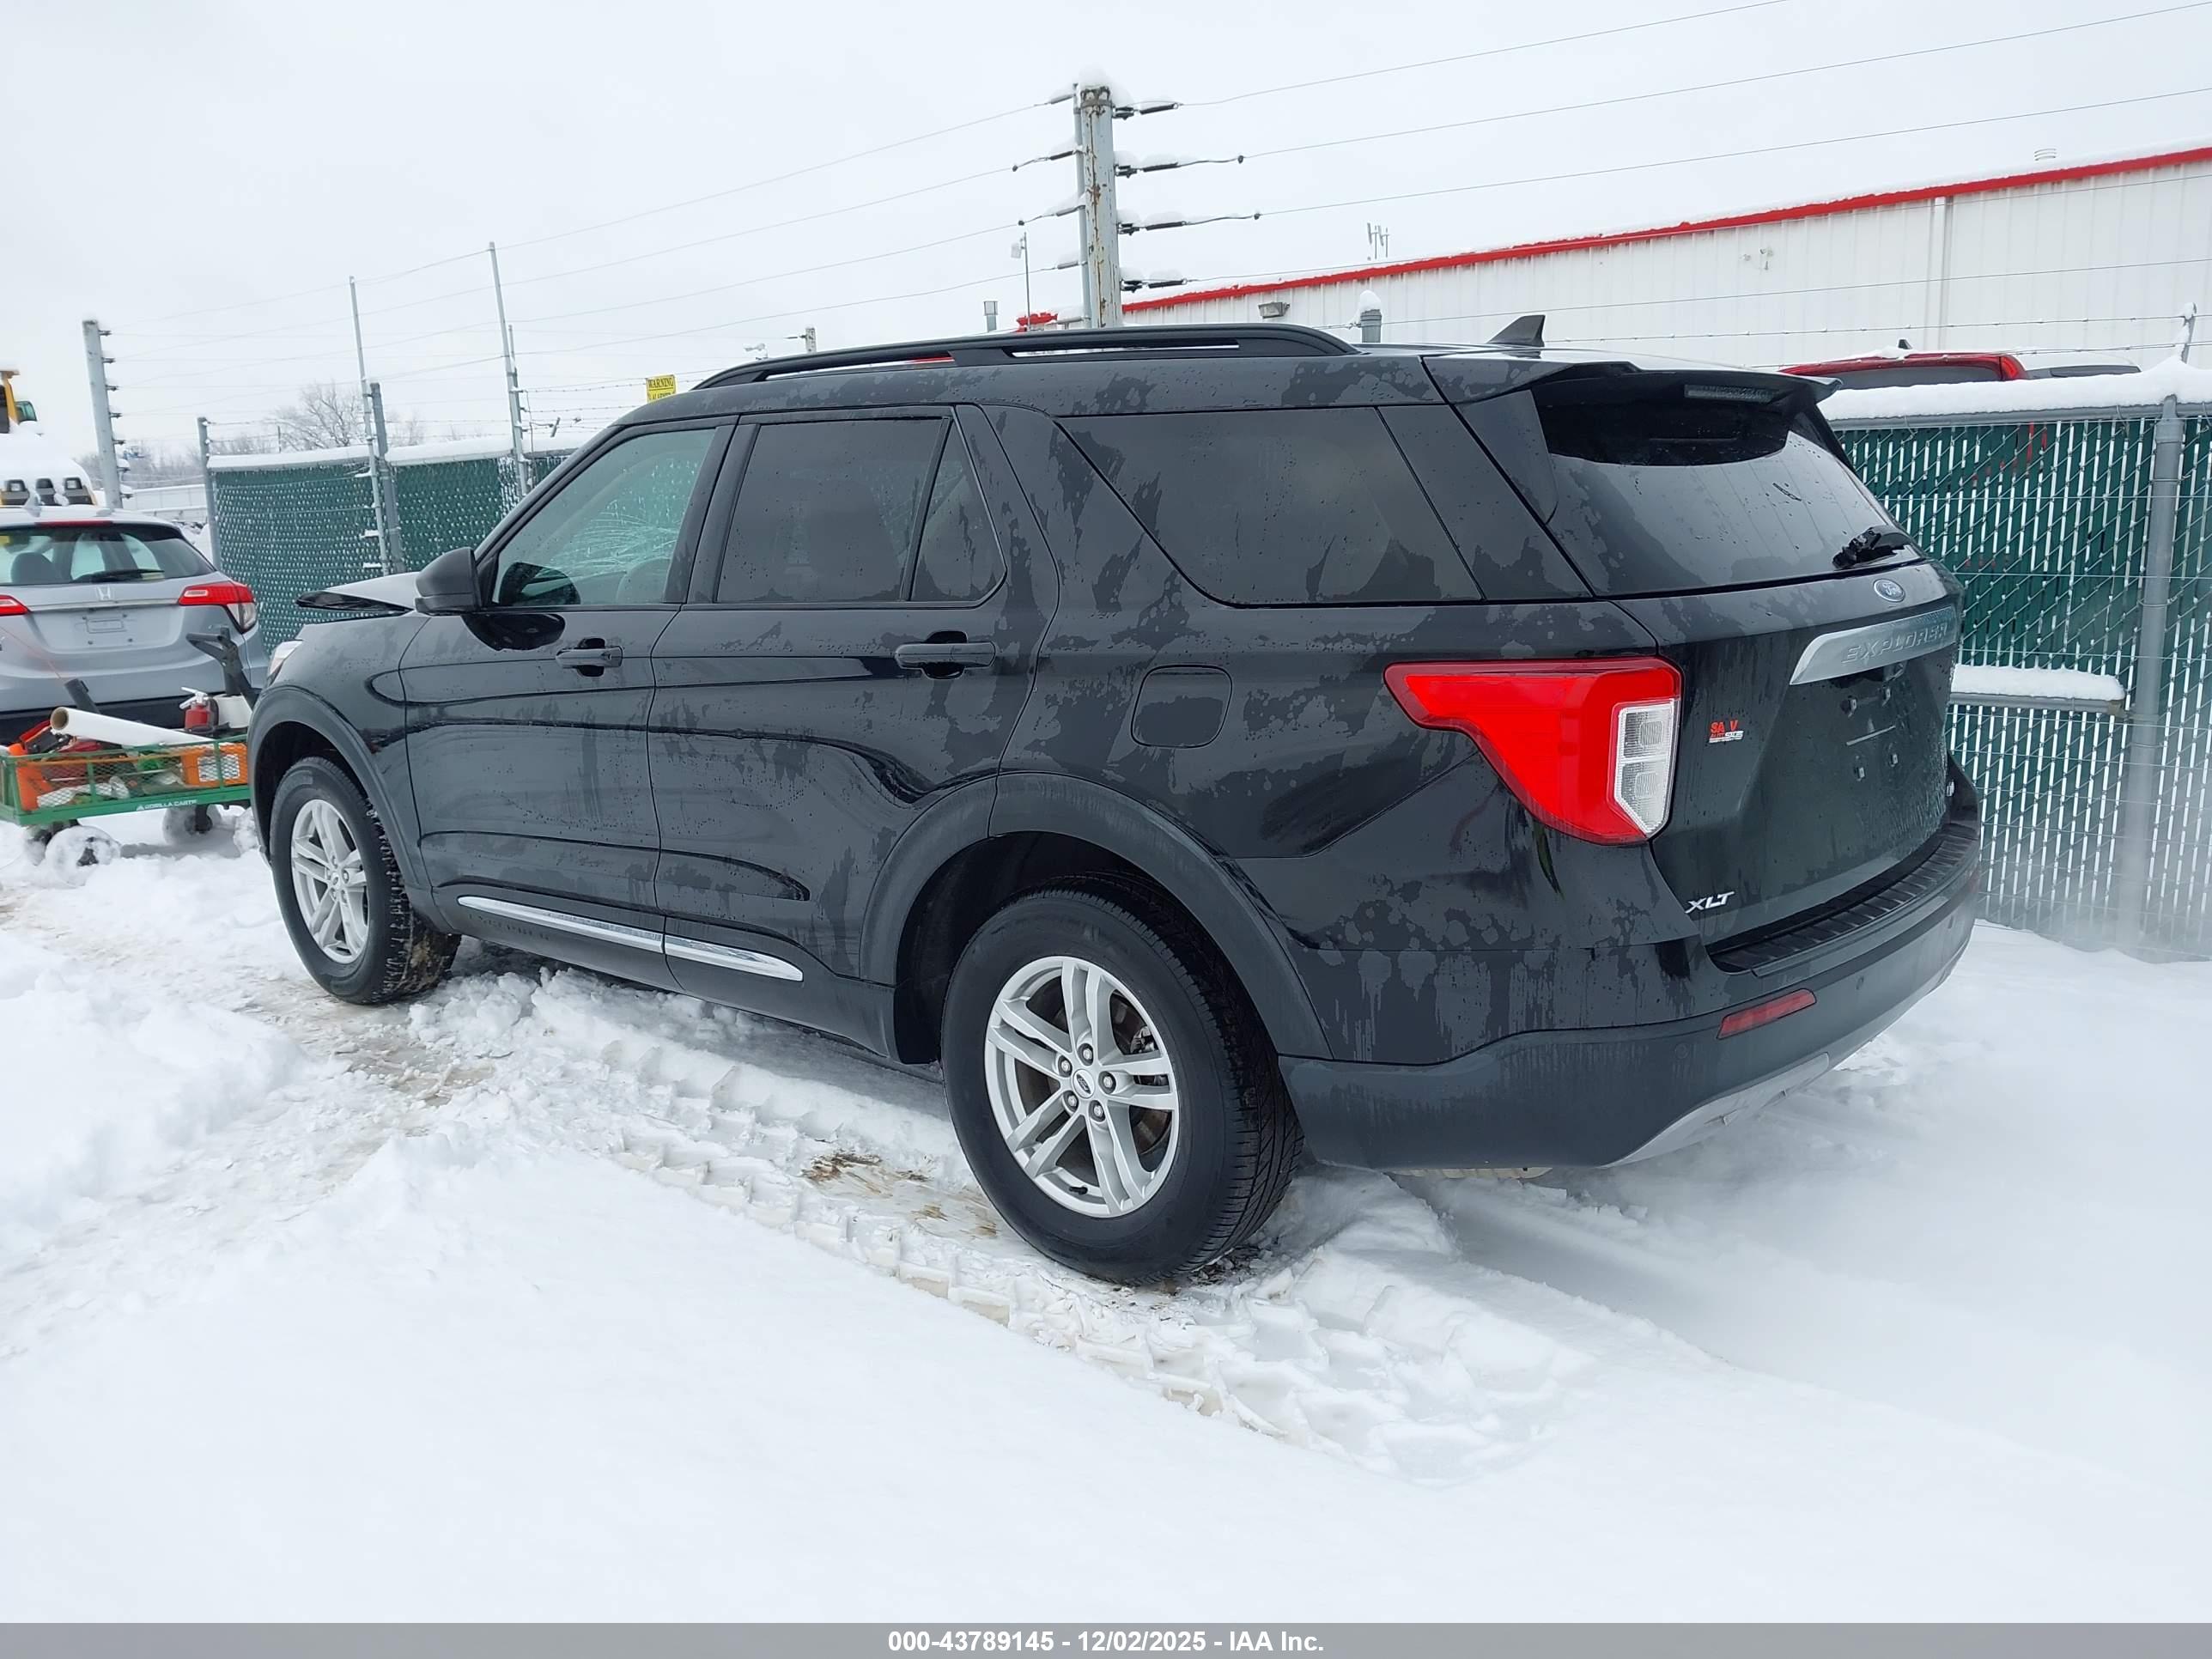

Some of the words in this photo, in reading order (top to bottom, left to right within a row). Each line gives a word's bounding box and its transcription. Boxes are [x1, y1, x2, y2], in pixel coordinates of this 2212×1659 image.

[647, 378, 673, 387] WARNING
[1843, 623, 1948, 663] EXPLORER
[1685, 891, 1735, 914] XLT
